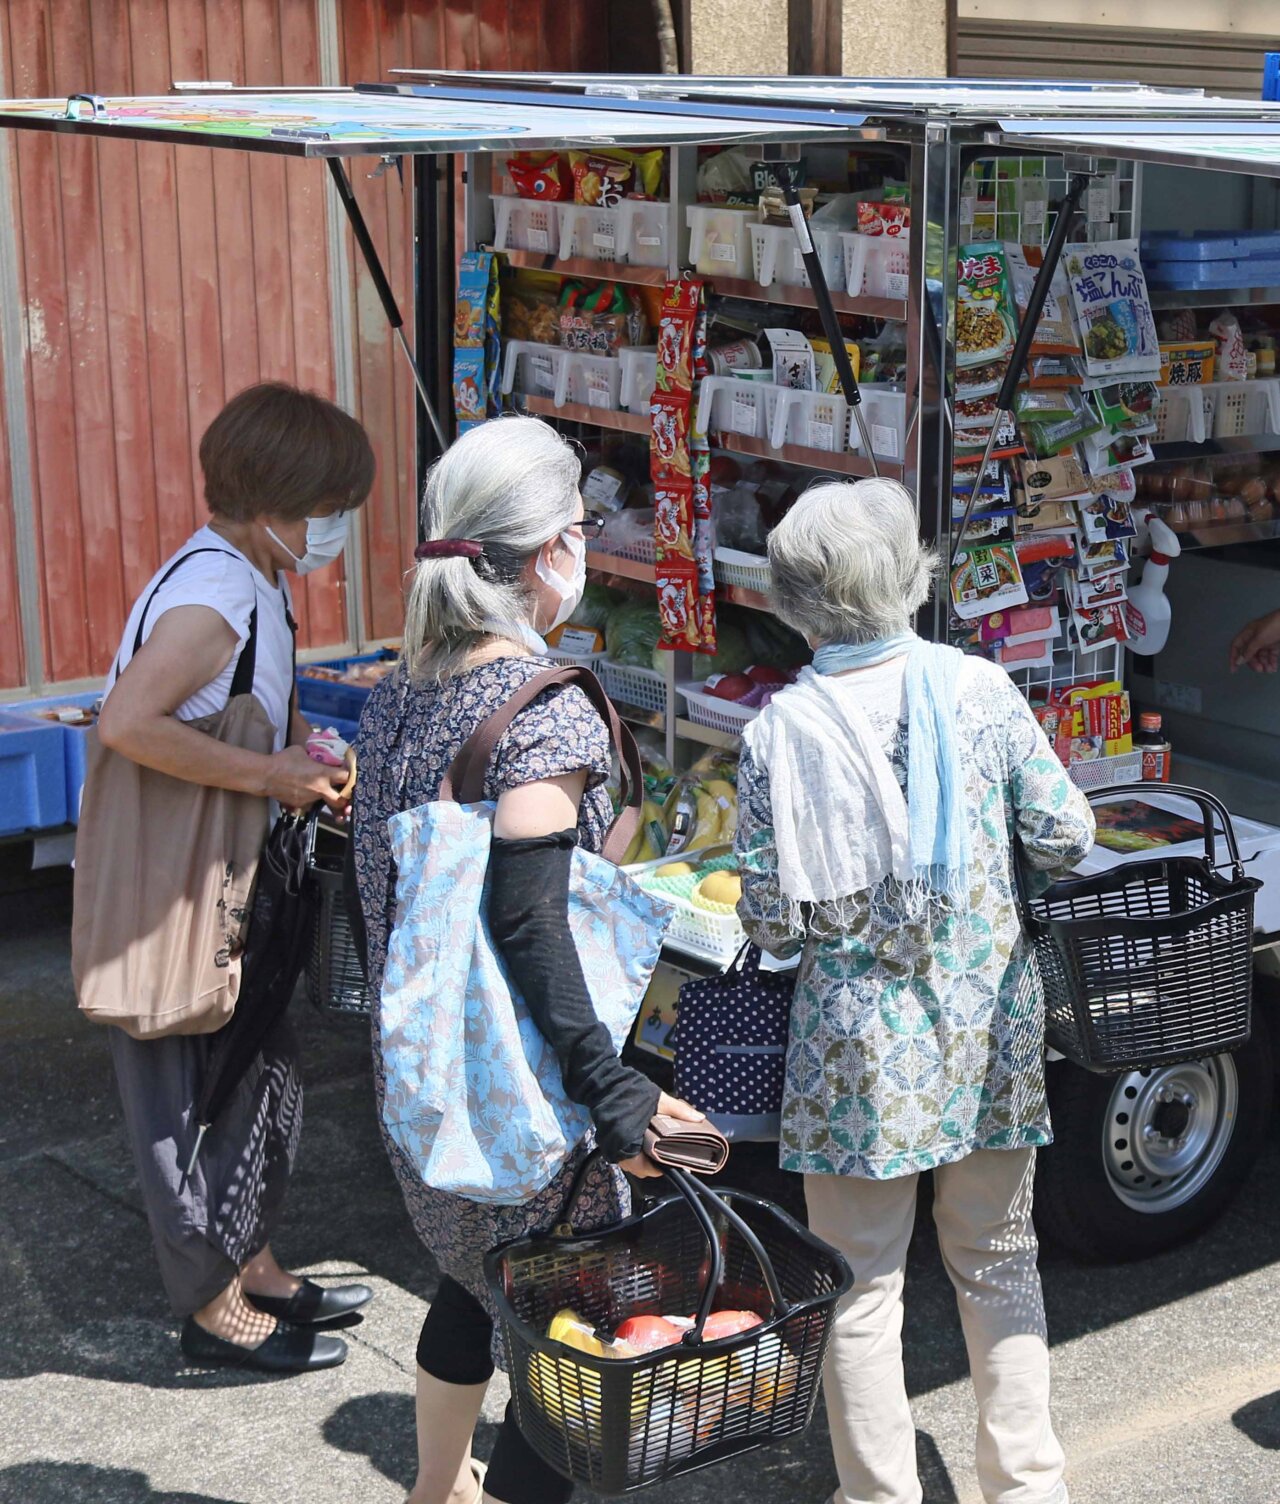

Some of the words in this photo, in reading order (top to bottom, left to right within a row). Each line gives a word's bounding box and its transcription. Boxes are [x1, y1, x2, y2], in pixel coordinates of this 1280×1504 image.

[1085, 255, 1117, 268] くらこん
[1075, 271, 1143, 303] 塩こんぶ
[1169, 361, 1202, 384] 焼豚
[975, 549, 995, 583] 野菜
[1110, 699, 1118, 738] コンソメ
